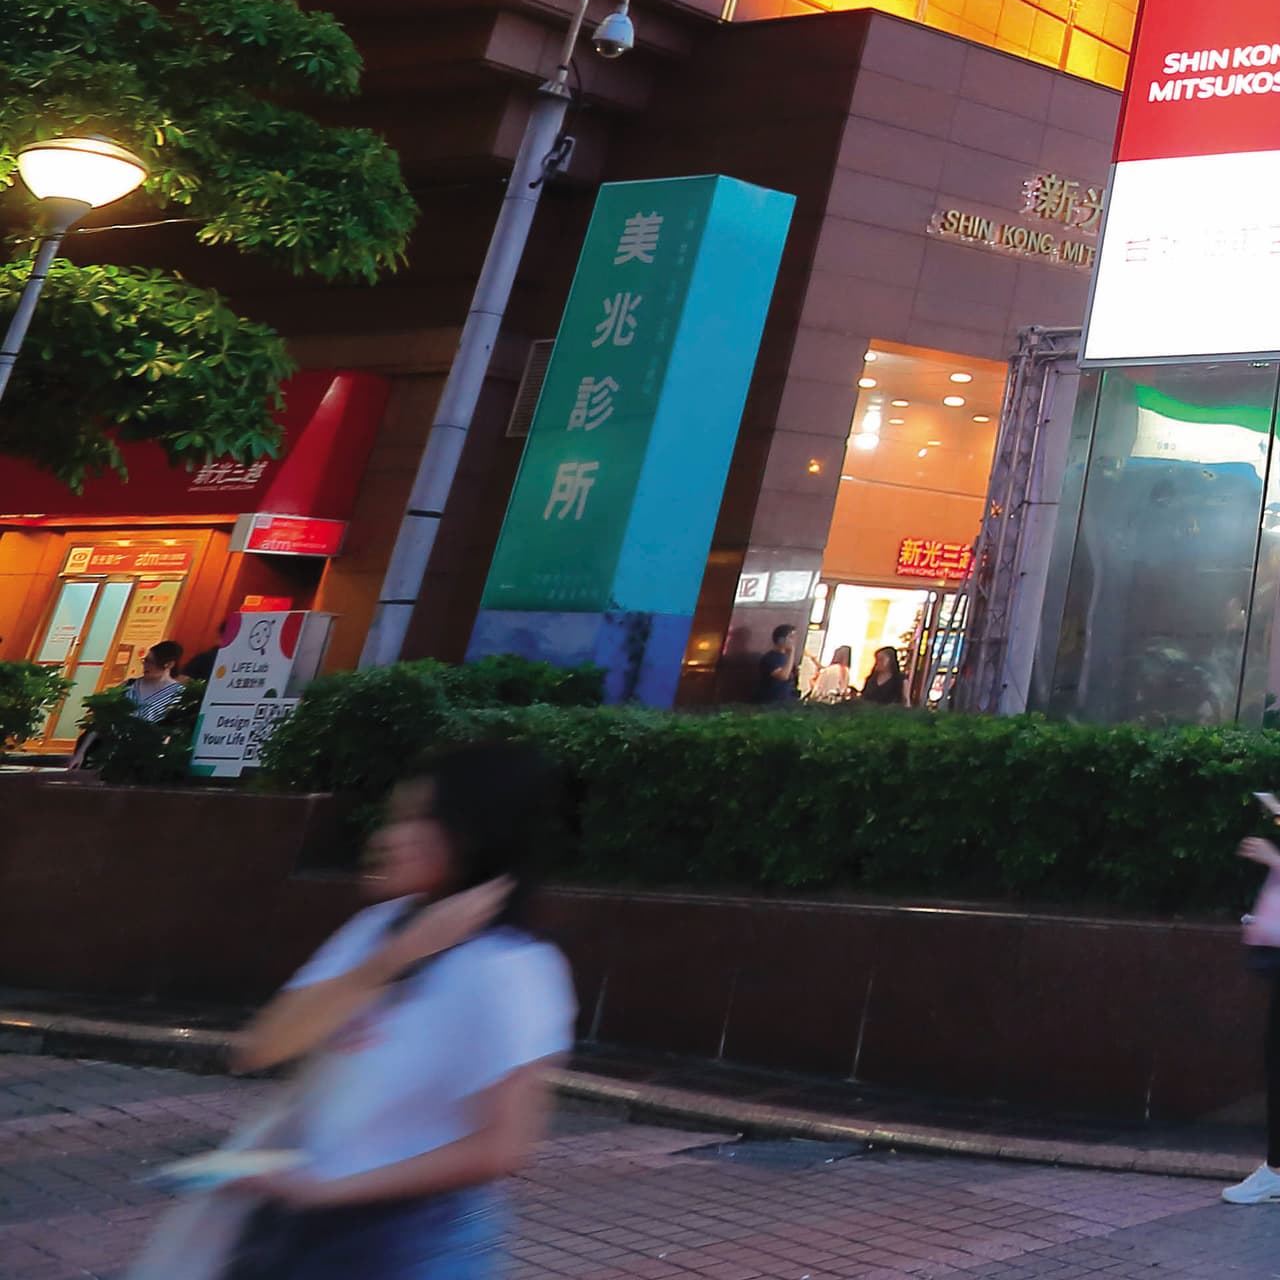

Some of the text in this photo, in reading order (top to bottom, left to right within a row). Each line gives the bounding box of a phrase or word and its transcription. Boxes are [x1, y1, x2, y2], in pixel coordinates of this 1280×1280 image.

[1163, 48, 1229, 74] SHIN
[943, 209, 994, 240] SHIN
[1000, 223, 1054, 254] KONG
[543, 210, 665, 521] 美兆診所
[216, 715, 250, 731] Design
[203, 732, 246, 746] Your Life
